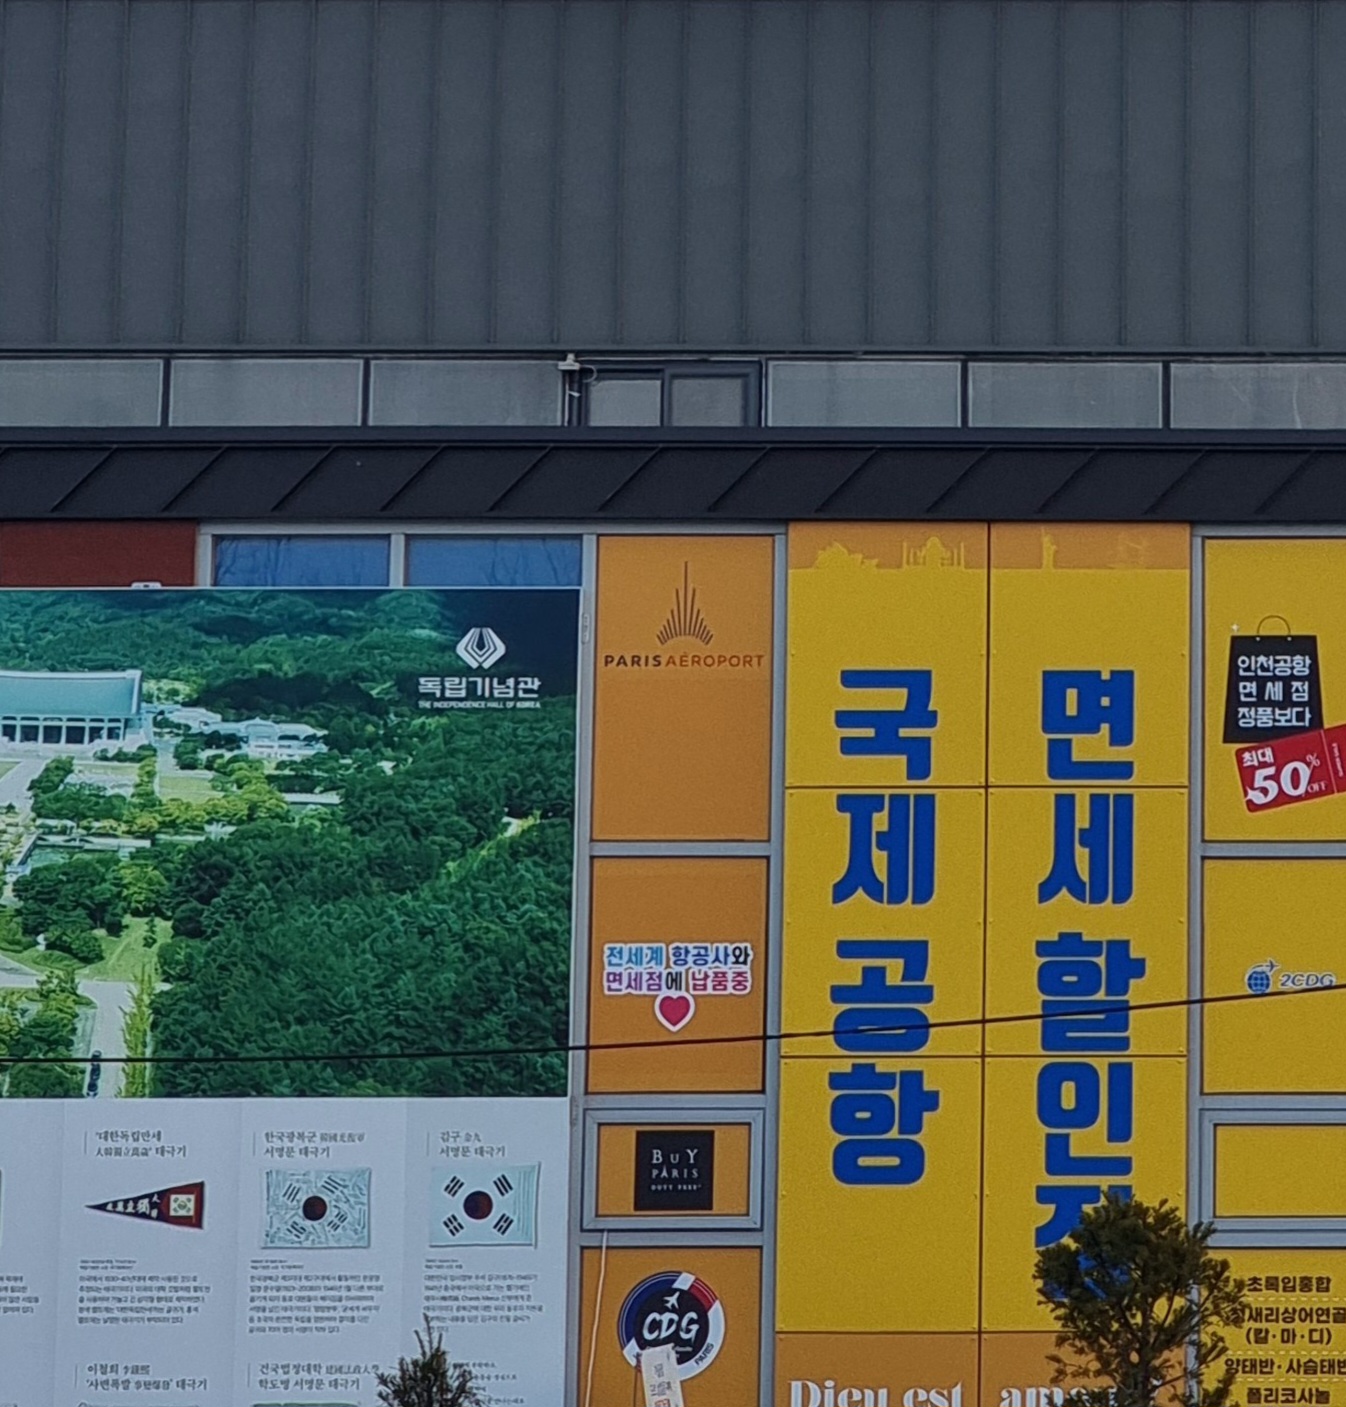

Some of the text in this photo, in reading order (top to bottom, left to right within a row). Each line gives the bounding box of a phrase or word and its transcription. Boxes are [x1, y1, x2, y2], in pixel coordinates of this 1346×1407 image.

[604, 651, 765, 668] PARIS AÉROPORT
[1237, 654, 1312, 677] 인천공항
[418, 676, 542, 699] 독립기념관
[1237, 706, 1312, 728] 정품보다
[1241, 746, 1275, 768] 최대
[605, 944, 751, 968] 전세계 항공사와
[605, 970, 750, 993] 면세점에 납품중
[1279, 972, 1335, 988] 2CDG
[155, 1145, 187, 1158] 태극기
[298, 1145, 331, 1158] 태극기
[474, 1145, 506, 1158] 태극기
[651, 1164, 699, 1180] PARIS
[1246, 1275, 1332, 1293] 초록입홍합
[642, 1310, 700, 1341] CDG
[175, 1378, 208, 1391] 태극기
[328, 1377, 360, 1390] 태극기
[1246, 1386, 1331, 1405] 폴리코사놀
